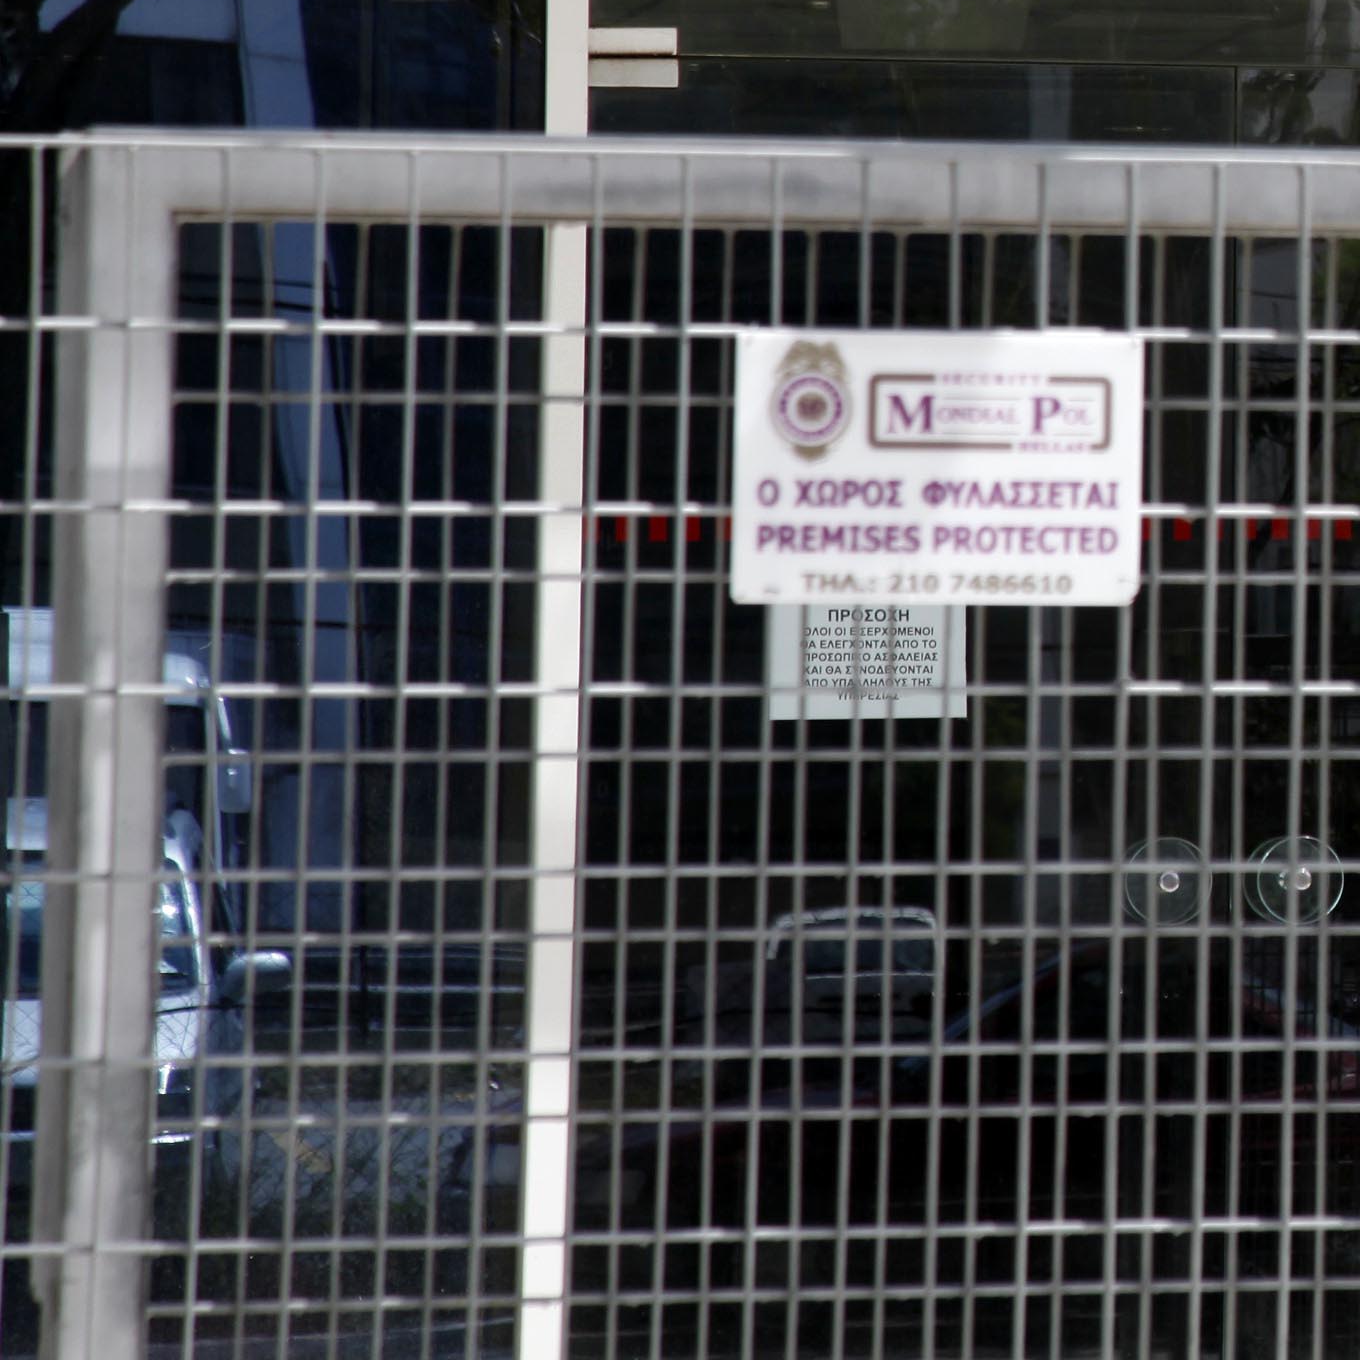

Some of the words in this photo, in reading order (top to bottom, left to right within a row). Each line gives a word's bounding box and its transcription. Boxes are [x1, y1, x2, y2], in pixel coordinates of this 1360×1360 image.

[795, 480, 903, 508] ΧΩΡΟΣ
[922, 481, 1119, 509] ΦΥΛΑΣΣΕΤΑΙ
[756, 524, 921, 553] PREMISES
[932, 525, 1120, 554] PROTECTED
[889, 574, 940, 593] 210
[952, 574, 1074, 594] 7486610
[828, 608, 910, 622] ΠΡΟΣΟΧΗ
[850, 626, 934, 637] ΕΣΕΡΧΟΜΕΝΟΙ
[820, 639, 891, 649] ΕΛΕΓΧΟΝΤΑ
[894, 640, 919, 649] ΑΠΟ
[922, 639, 937, 649] ΤΟ
[804, 652, 871, 662] ΠΡΟΣΩΠΙΟ
[825, 665, 842, 674] ΘΑ
[845, 665, 933, 674] ΣΝΟΔΕΥΟΝΤΑΙ
